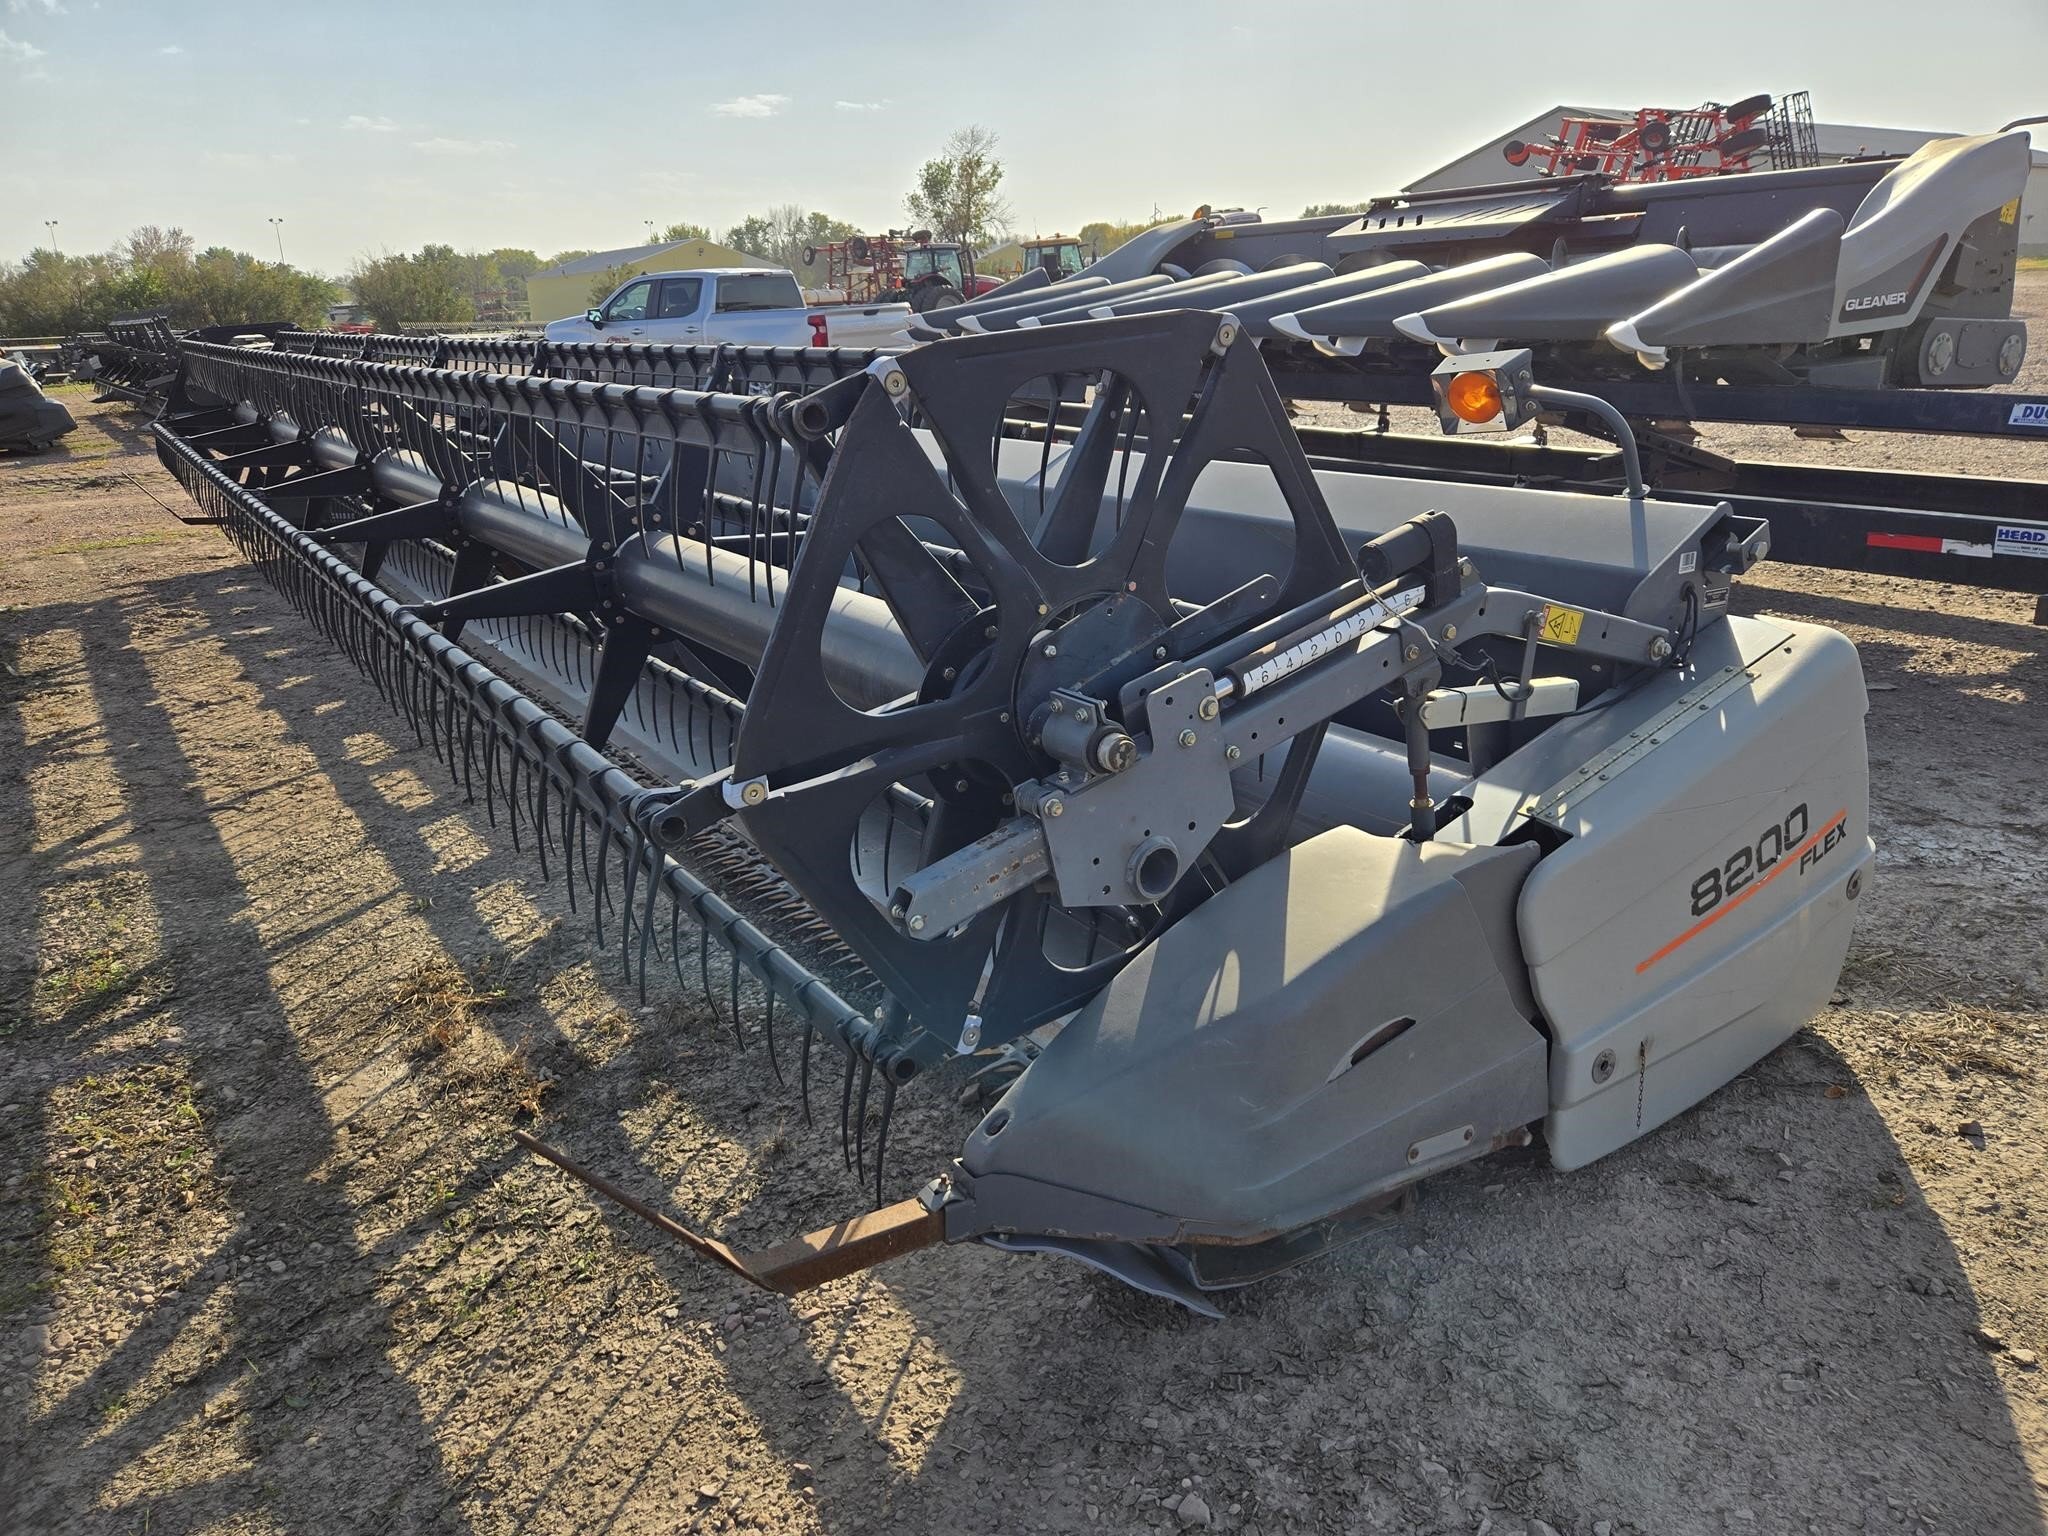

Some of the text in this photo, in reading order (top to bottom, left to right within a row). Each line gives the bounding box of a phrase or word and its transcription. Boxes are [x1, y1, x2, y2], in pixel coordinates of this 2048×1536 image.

[1845, 291, 1907, 311] GLEANER
[1998, 528, 2046, 542] HEAD
[1261, 670, 1269, 683] 6
[1286, 657, 1294, 670] 4
[1310, 644, 1318, 657] 2
[1334, 631, 1342, 644] 0
[1358, 618, 1366, 631] 2
[1404, 593, 1411, 606] 6
[1690, 802, 1809, 917] 8200
[1799, 817, 1848, 876] FLEX
